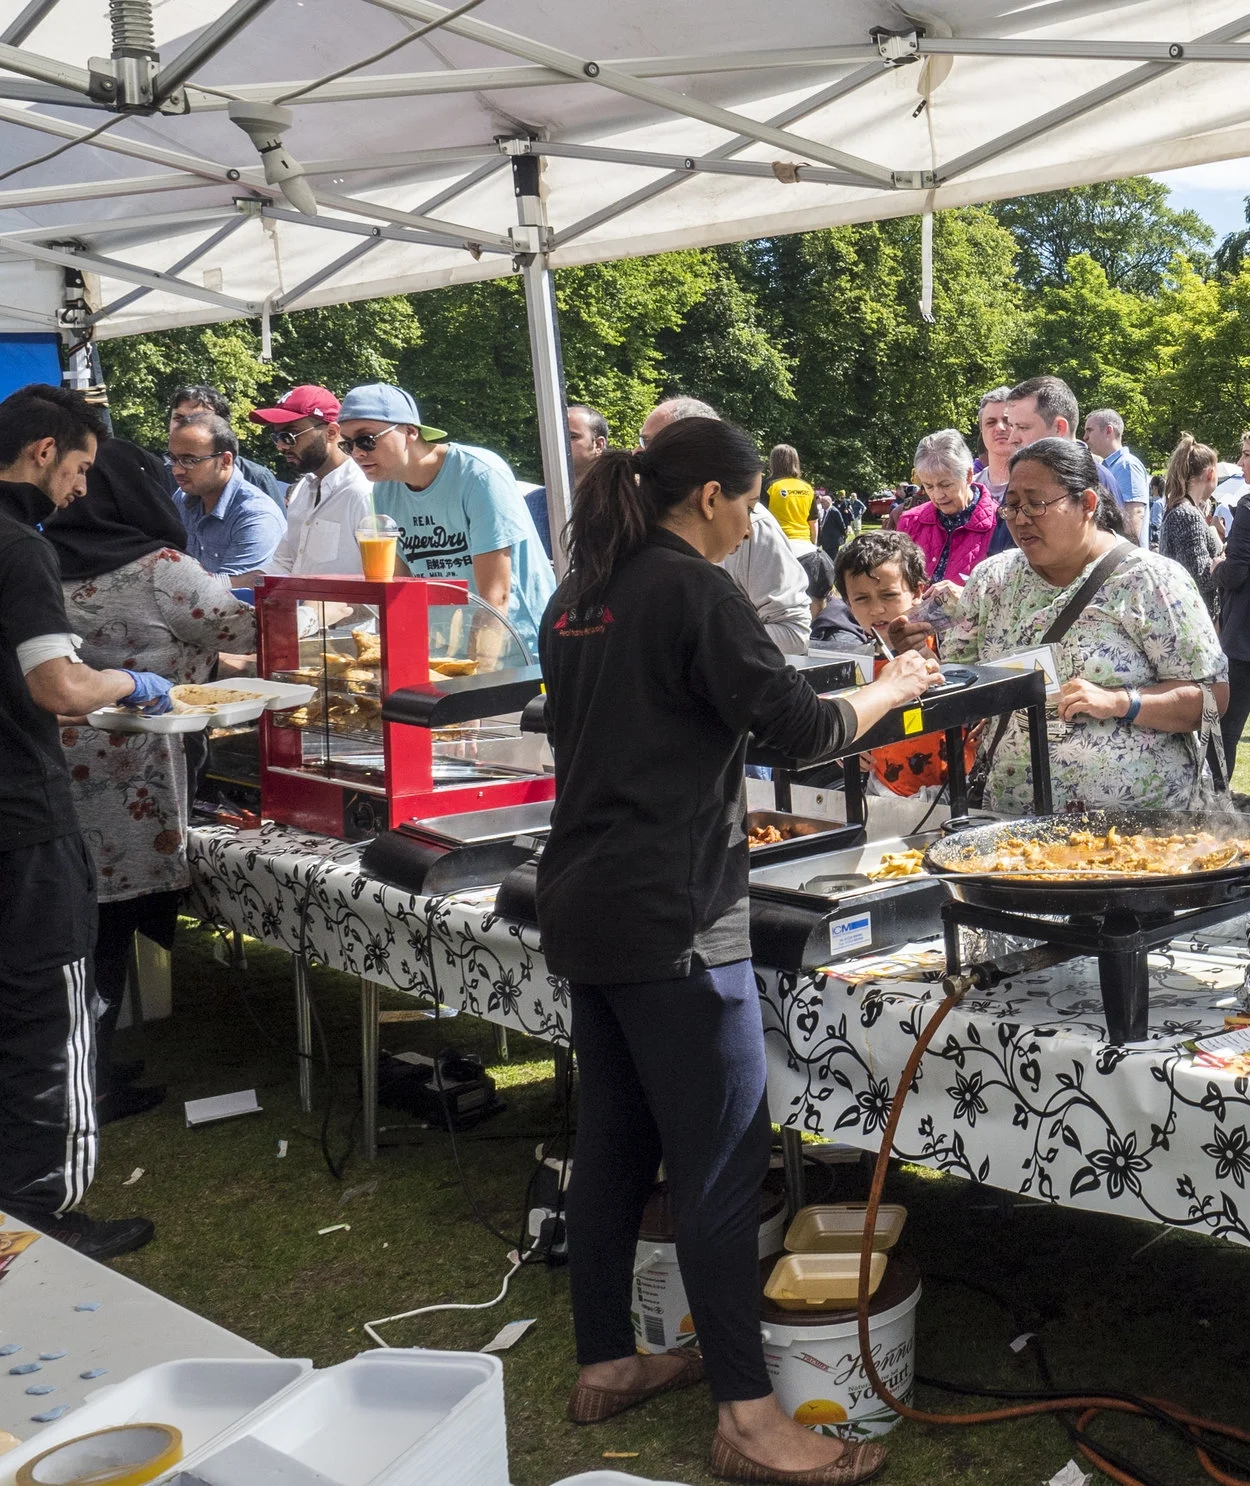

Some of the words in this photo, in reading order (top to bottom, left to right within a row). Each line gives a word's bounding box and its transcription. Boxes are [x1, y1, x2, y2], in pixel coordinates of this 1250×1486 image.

[412, 515, 436, 527] REAL
[831, 922, 853, 935] ICM
[848, 1363, 909, 1410] yourt
